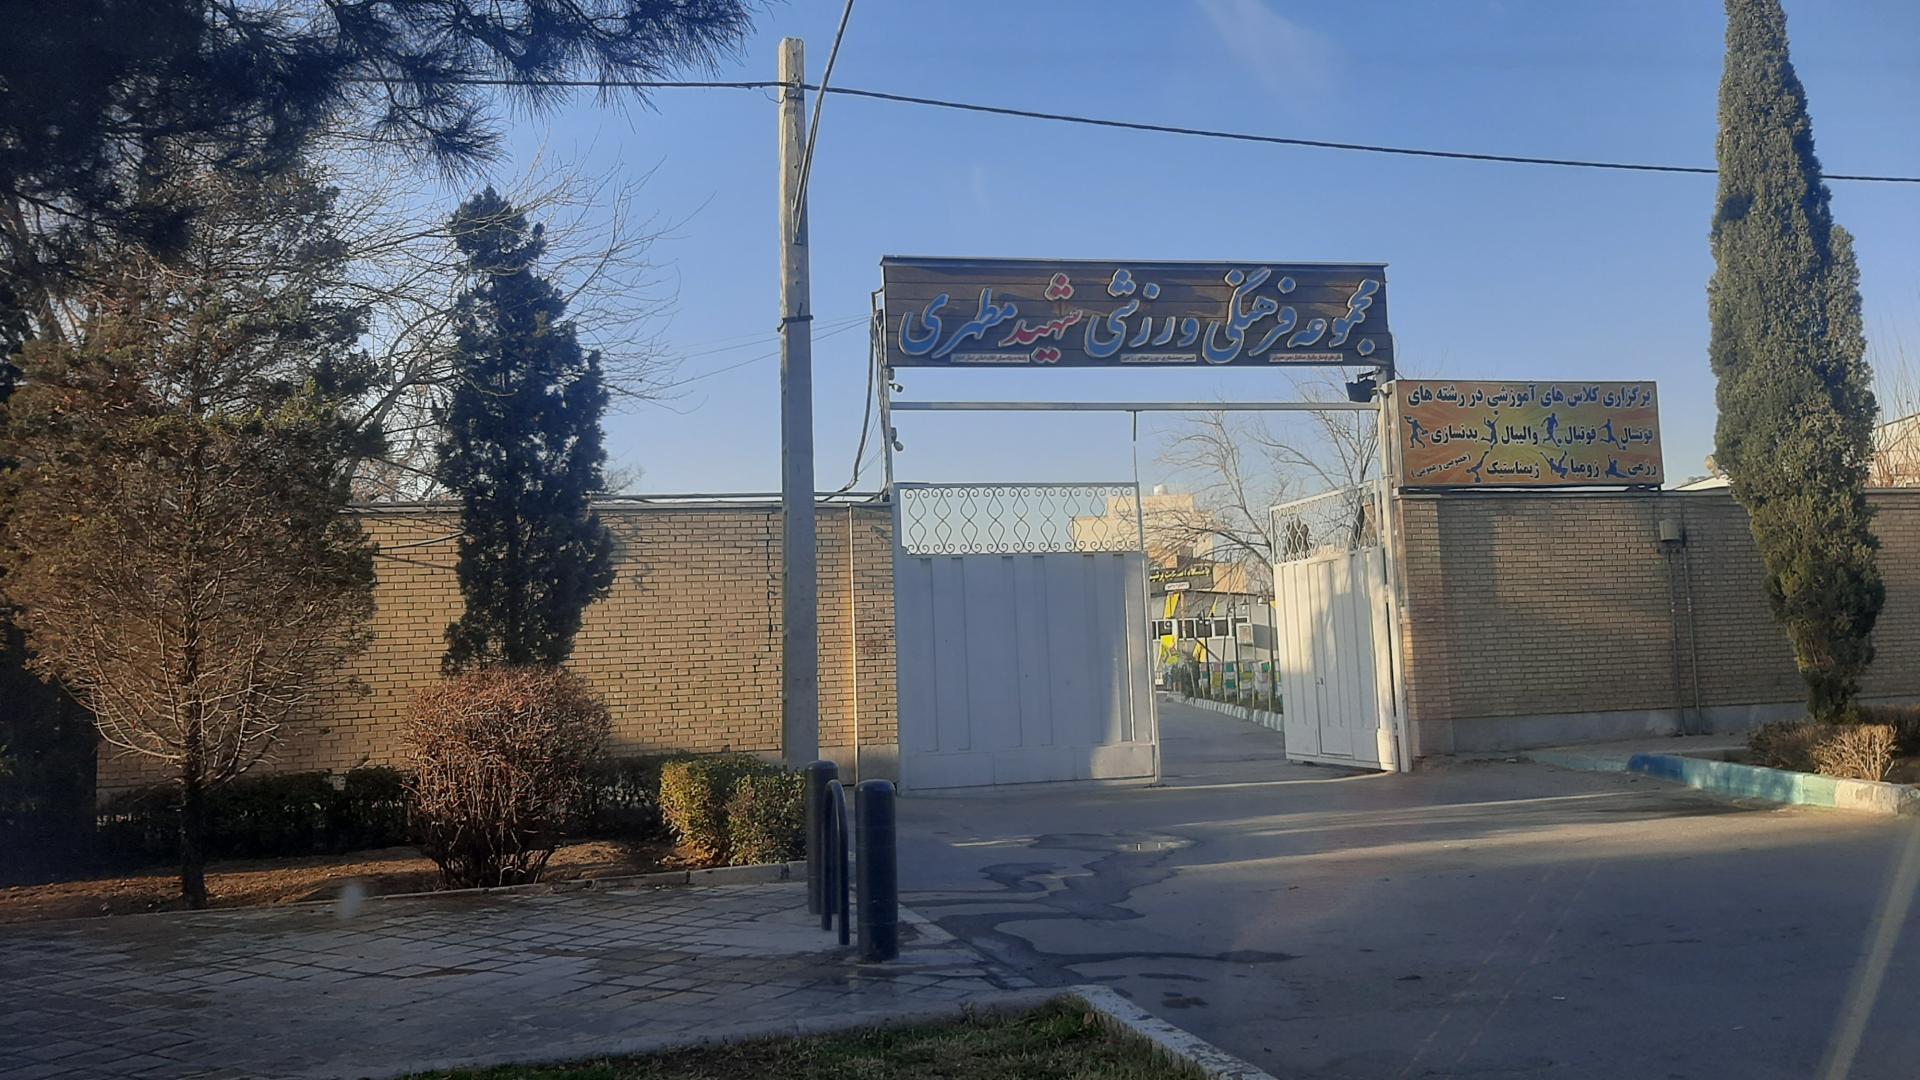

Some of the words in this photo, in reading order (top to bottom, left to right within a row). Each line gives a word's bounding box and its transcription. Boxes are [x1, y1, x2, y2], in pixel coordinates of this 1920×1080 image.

[898, 287, 1018, 358] مطهری
[998, 272, 1083, 363] شهید
[1084, 268, 1199, 358] ورزشی
[1202, 267, 1297, 364] فرهنگی
[1286, 278, 1380, 356] مجموعه
[1407, 385, 1433, 406] های
[1436, 386, 1465, 407] رشته
[1469, 389, 1484, 407] در
[1487, 384, 1536, 408] آموزشی
[1540, 385, 1565, 407] های
[1567, 386, 1600, 407] کلاس
[1430, 424, 1478, 443] بدنسازی
[1501, 425, 1539, 445] والیبال
[1564, 425, 1597, 445] فوتبال
[1620, 426, 1654, 445] فوتسال
[1486, 461, 1540, 478] ژیمناستیک
[1570, 458, 1600, 478] زومبا
[1627, 461, 1657, 476] رزمی
